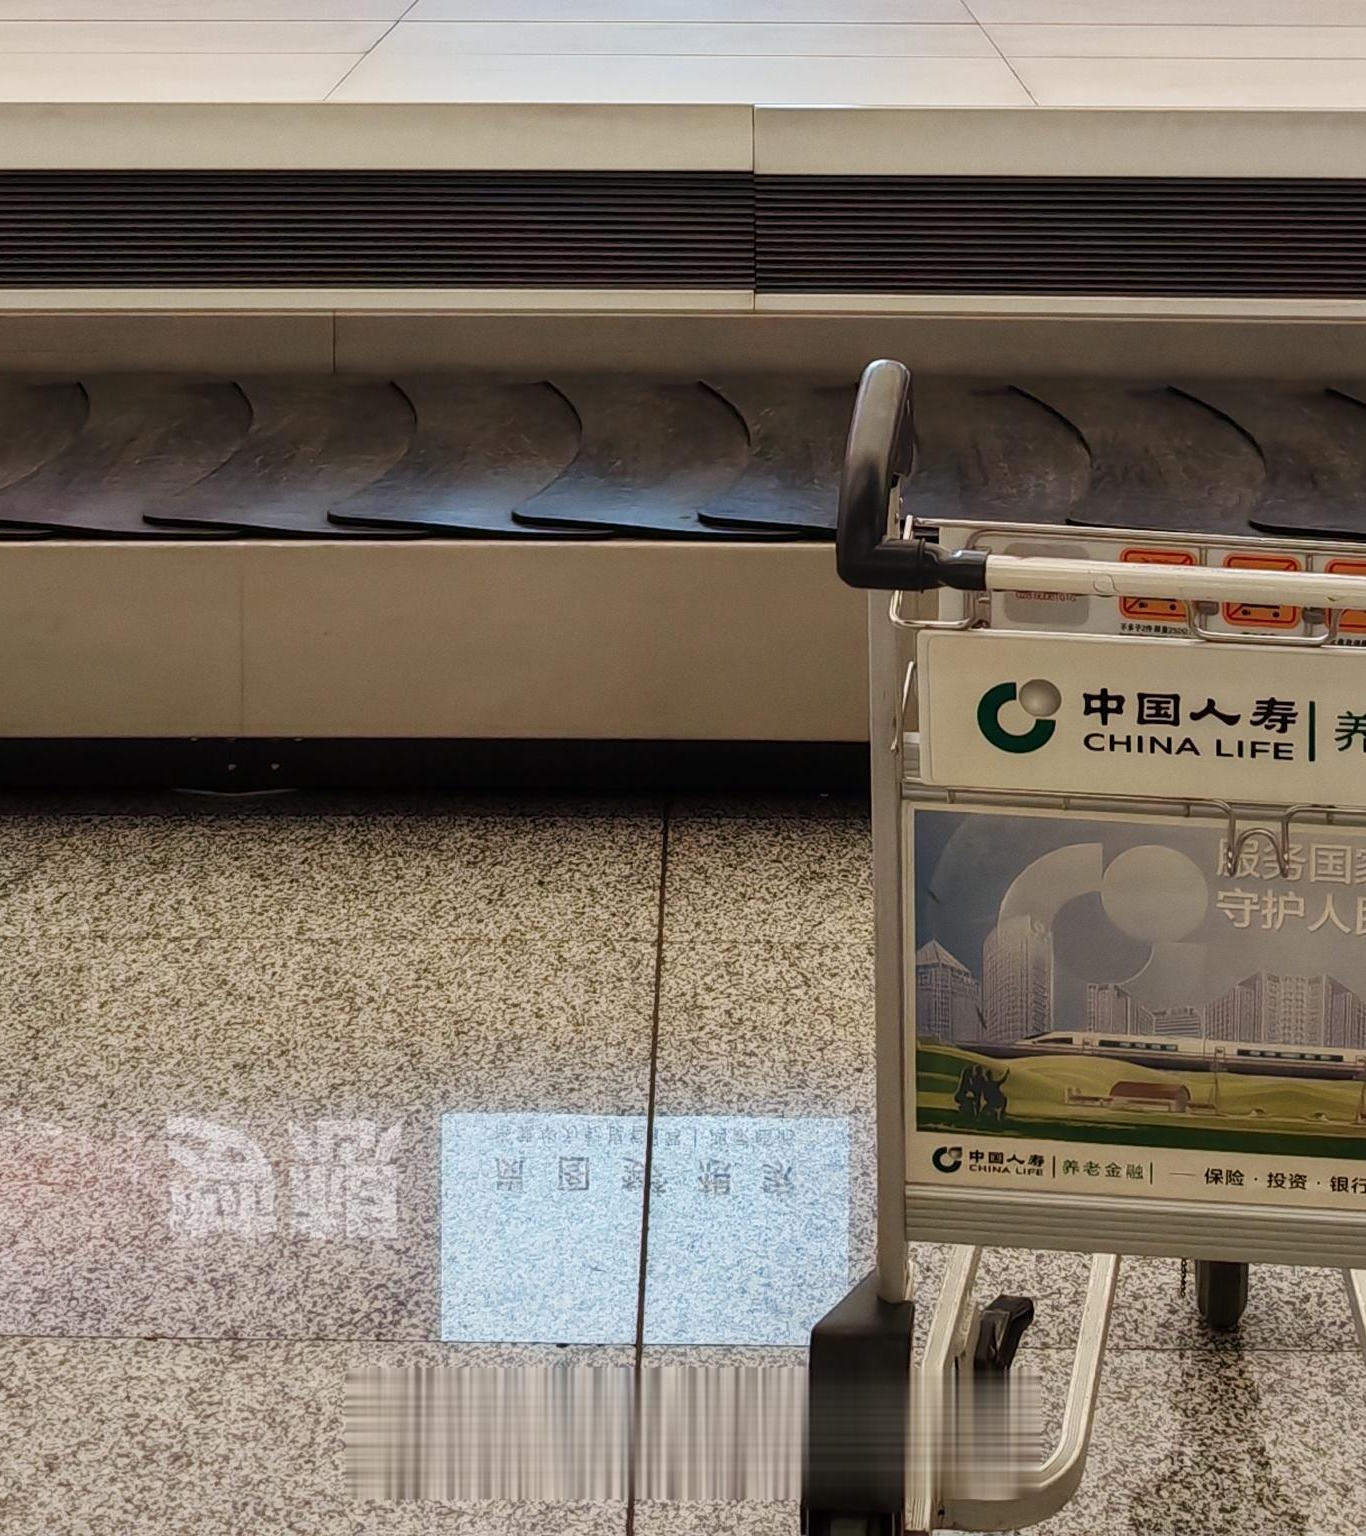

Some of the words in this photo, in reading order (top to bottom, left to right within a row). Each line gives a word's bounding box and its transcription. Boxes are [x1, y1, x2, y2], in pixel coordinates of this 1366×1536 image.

[1082, 687, 1299, 735] 中国人寿
[1082, 732, 1201, 757] CHINA
[1214, 738, 1295, 761] LIFE
[968, 1149, 1045, 1168] 中国人寿
[1062, 1158, 1144, 1180] 养老金融
[1203, 1167, 1246, 1186] 保险
[1266, 1171, 1307, 1191] 投资
[968, 1163, 1011, 1175] CHINA
[1015, 1166, 1045, 1177] LIFE
